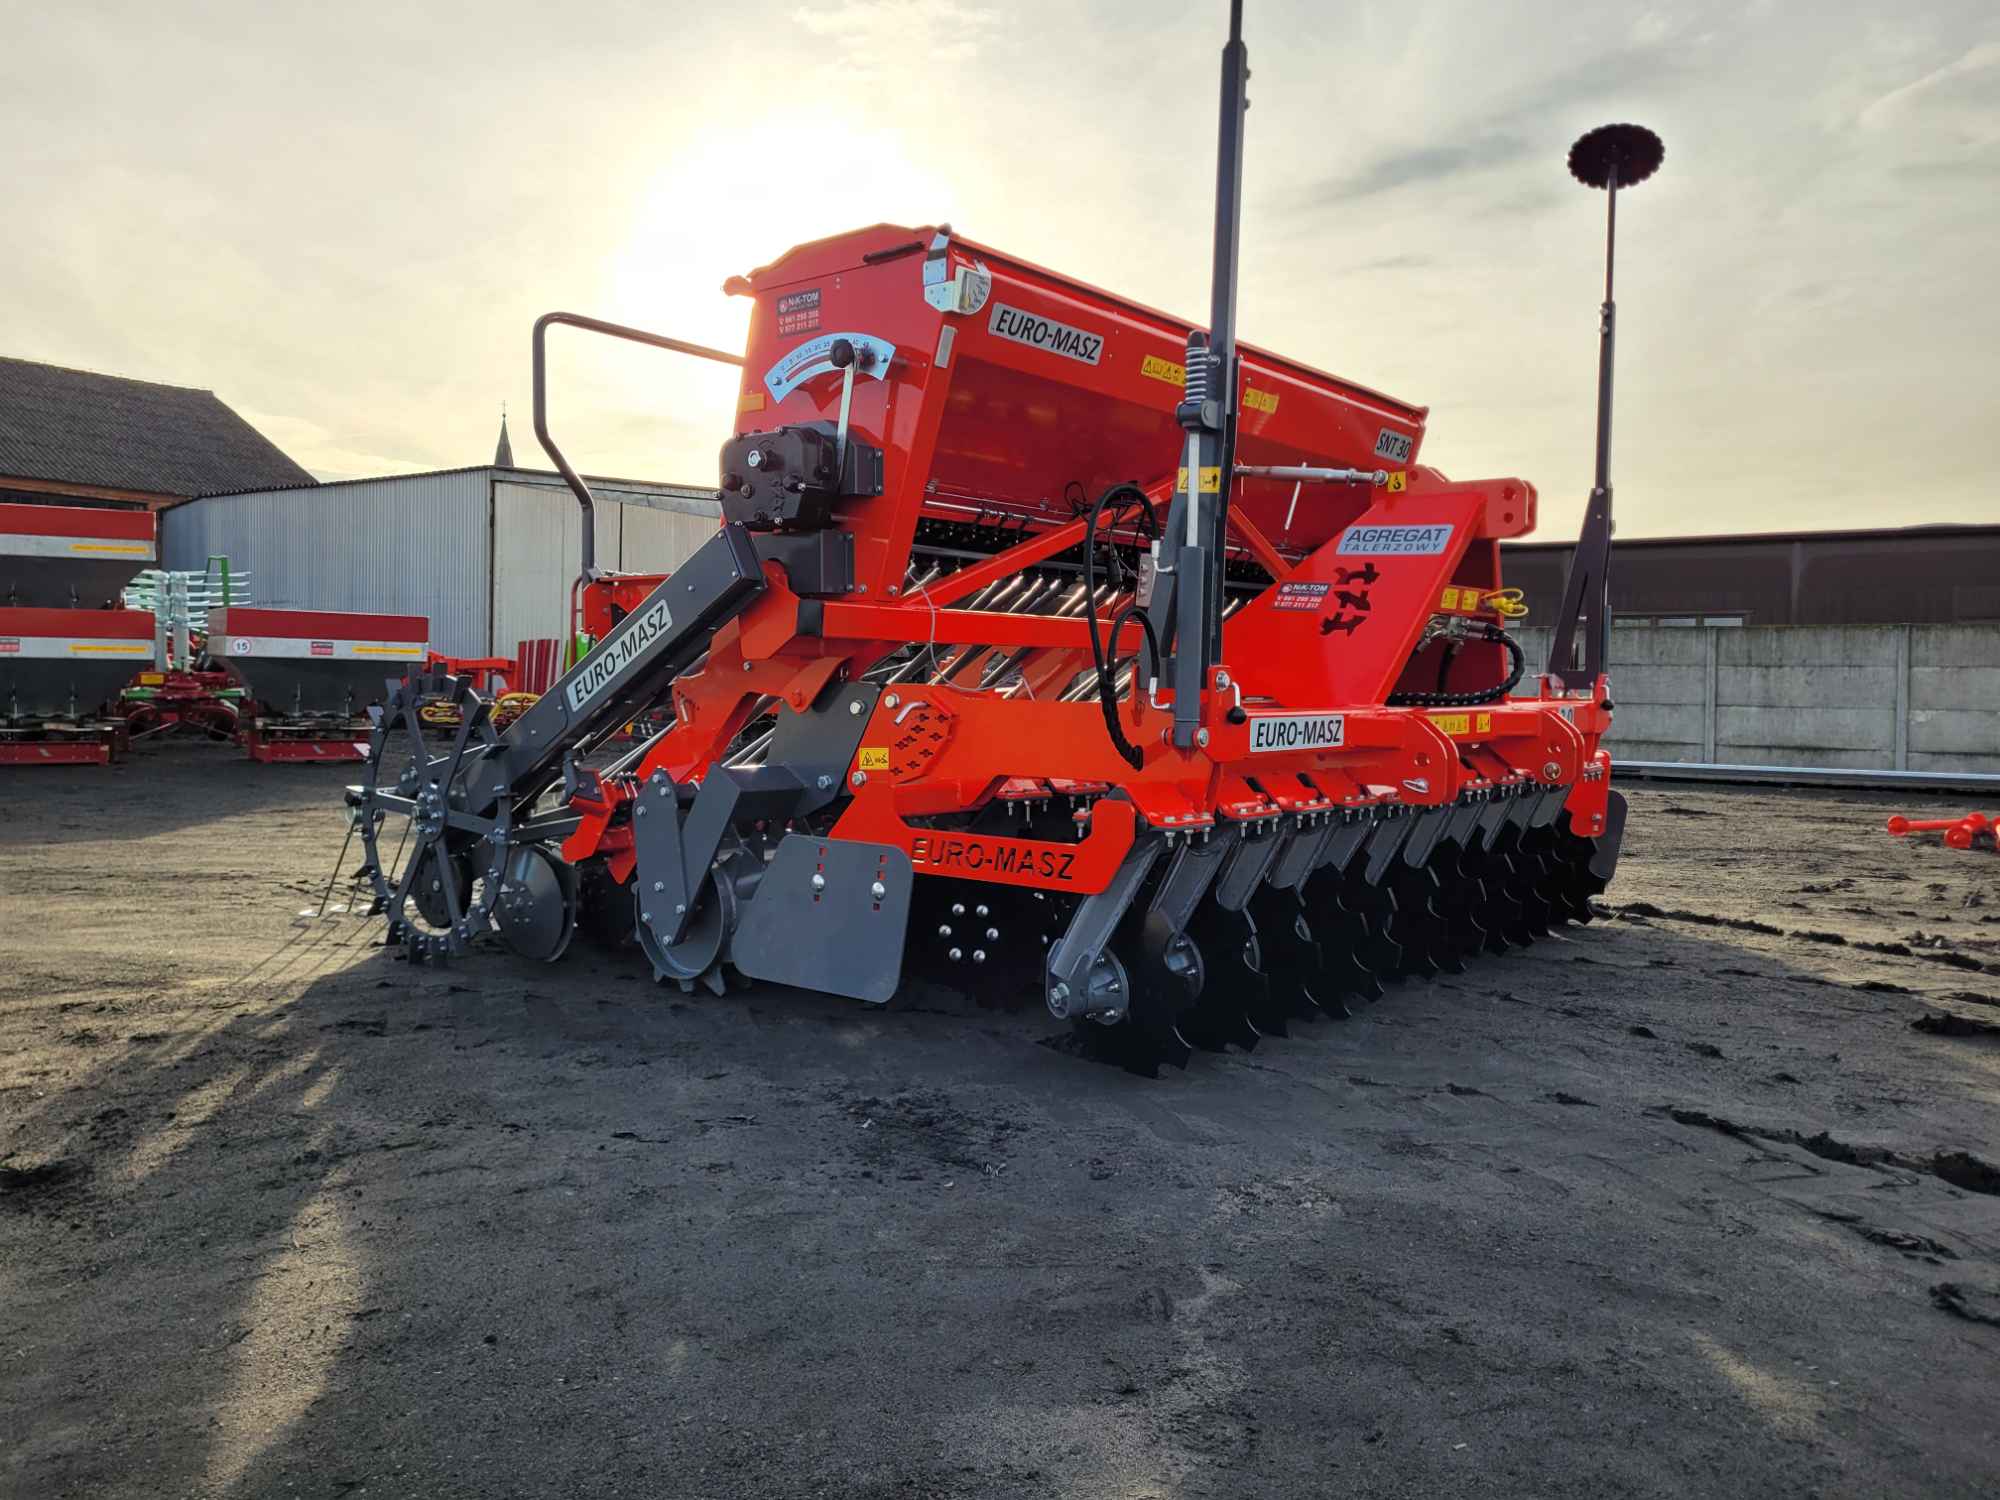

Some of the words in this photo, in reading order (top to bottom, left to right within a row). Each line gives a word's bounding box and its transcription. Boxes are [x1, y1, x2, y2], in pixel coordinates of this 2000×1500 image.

[995, 309, 1101, 361] EURO-MASZ
[1376, 432, 1400, 455] SNT
[1396, 439, 1411, 458] 30
[1343, 543, 1441, 552] TALERZOWY
[1346, 528, 1448, 543] AGREGAT
[236, 641, 248, 651] 15
[574, 604, 668, 705] EURO-MASZ
[1255, 719, 1342, 748] EURO-MASZ
[912, 837, 1075, 880] EURO-MASZ
